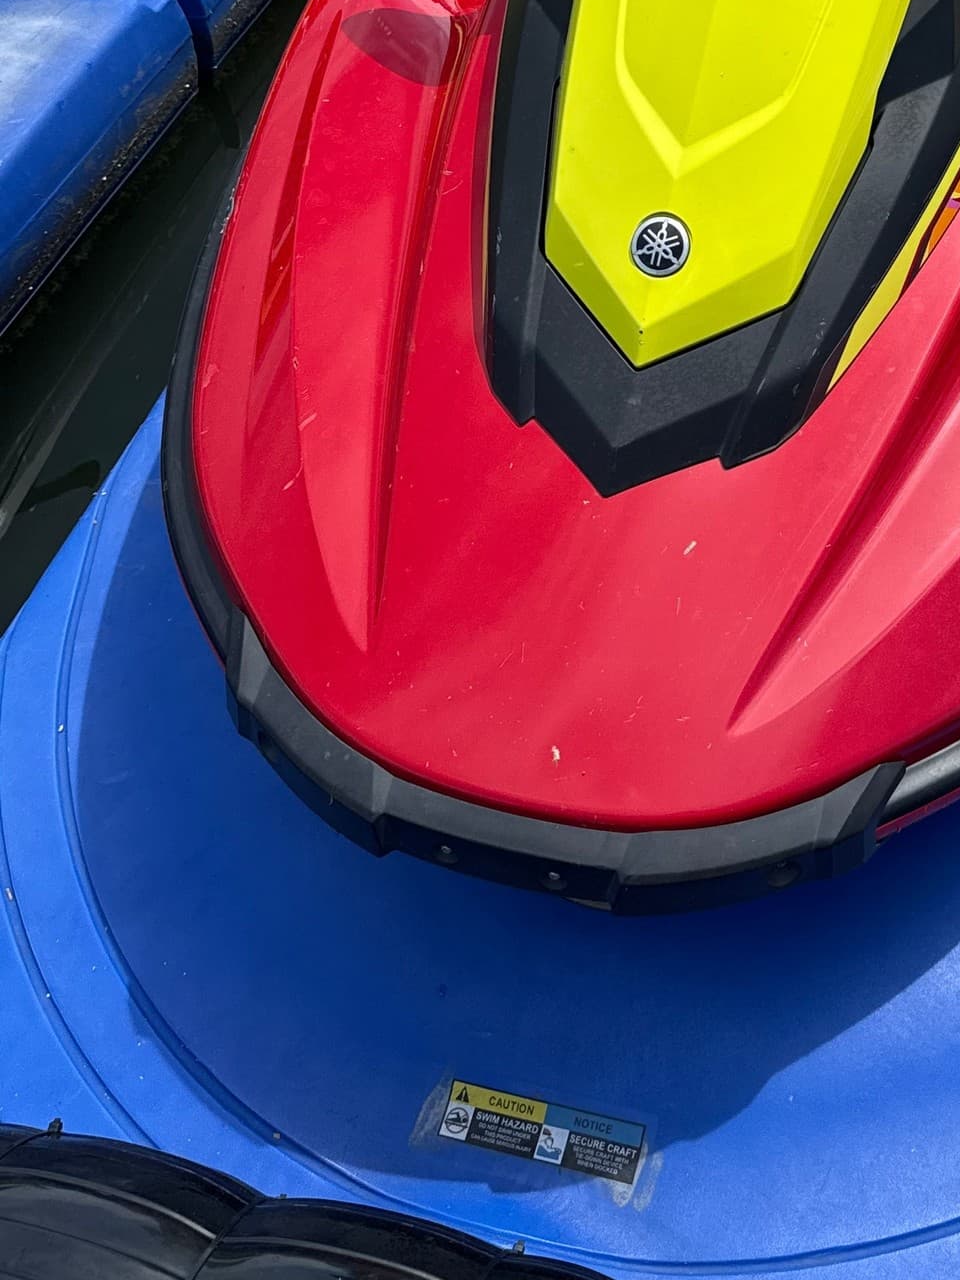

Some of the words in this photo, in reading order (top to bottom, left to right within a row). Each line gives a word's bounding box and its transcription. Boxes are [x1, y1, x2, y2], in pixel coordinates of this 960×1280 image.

[488, 1095, 535, 1116] CAUTION
[475, 1111, 501, 1124] SWIM
[501, 1117, 539, 1134] HAZARD
[574, 1116, 614, 1135] NOTICE
[569, 1134, 606, 1151] SECURE
[607, 1144, 637, 1159] CRAFT
